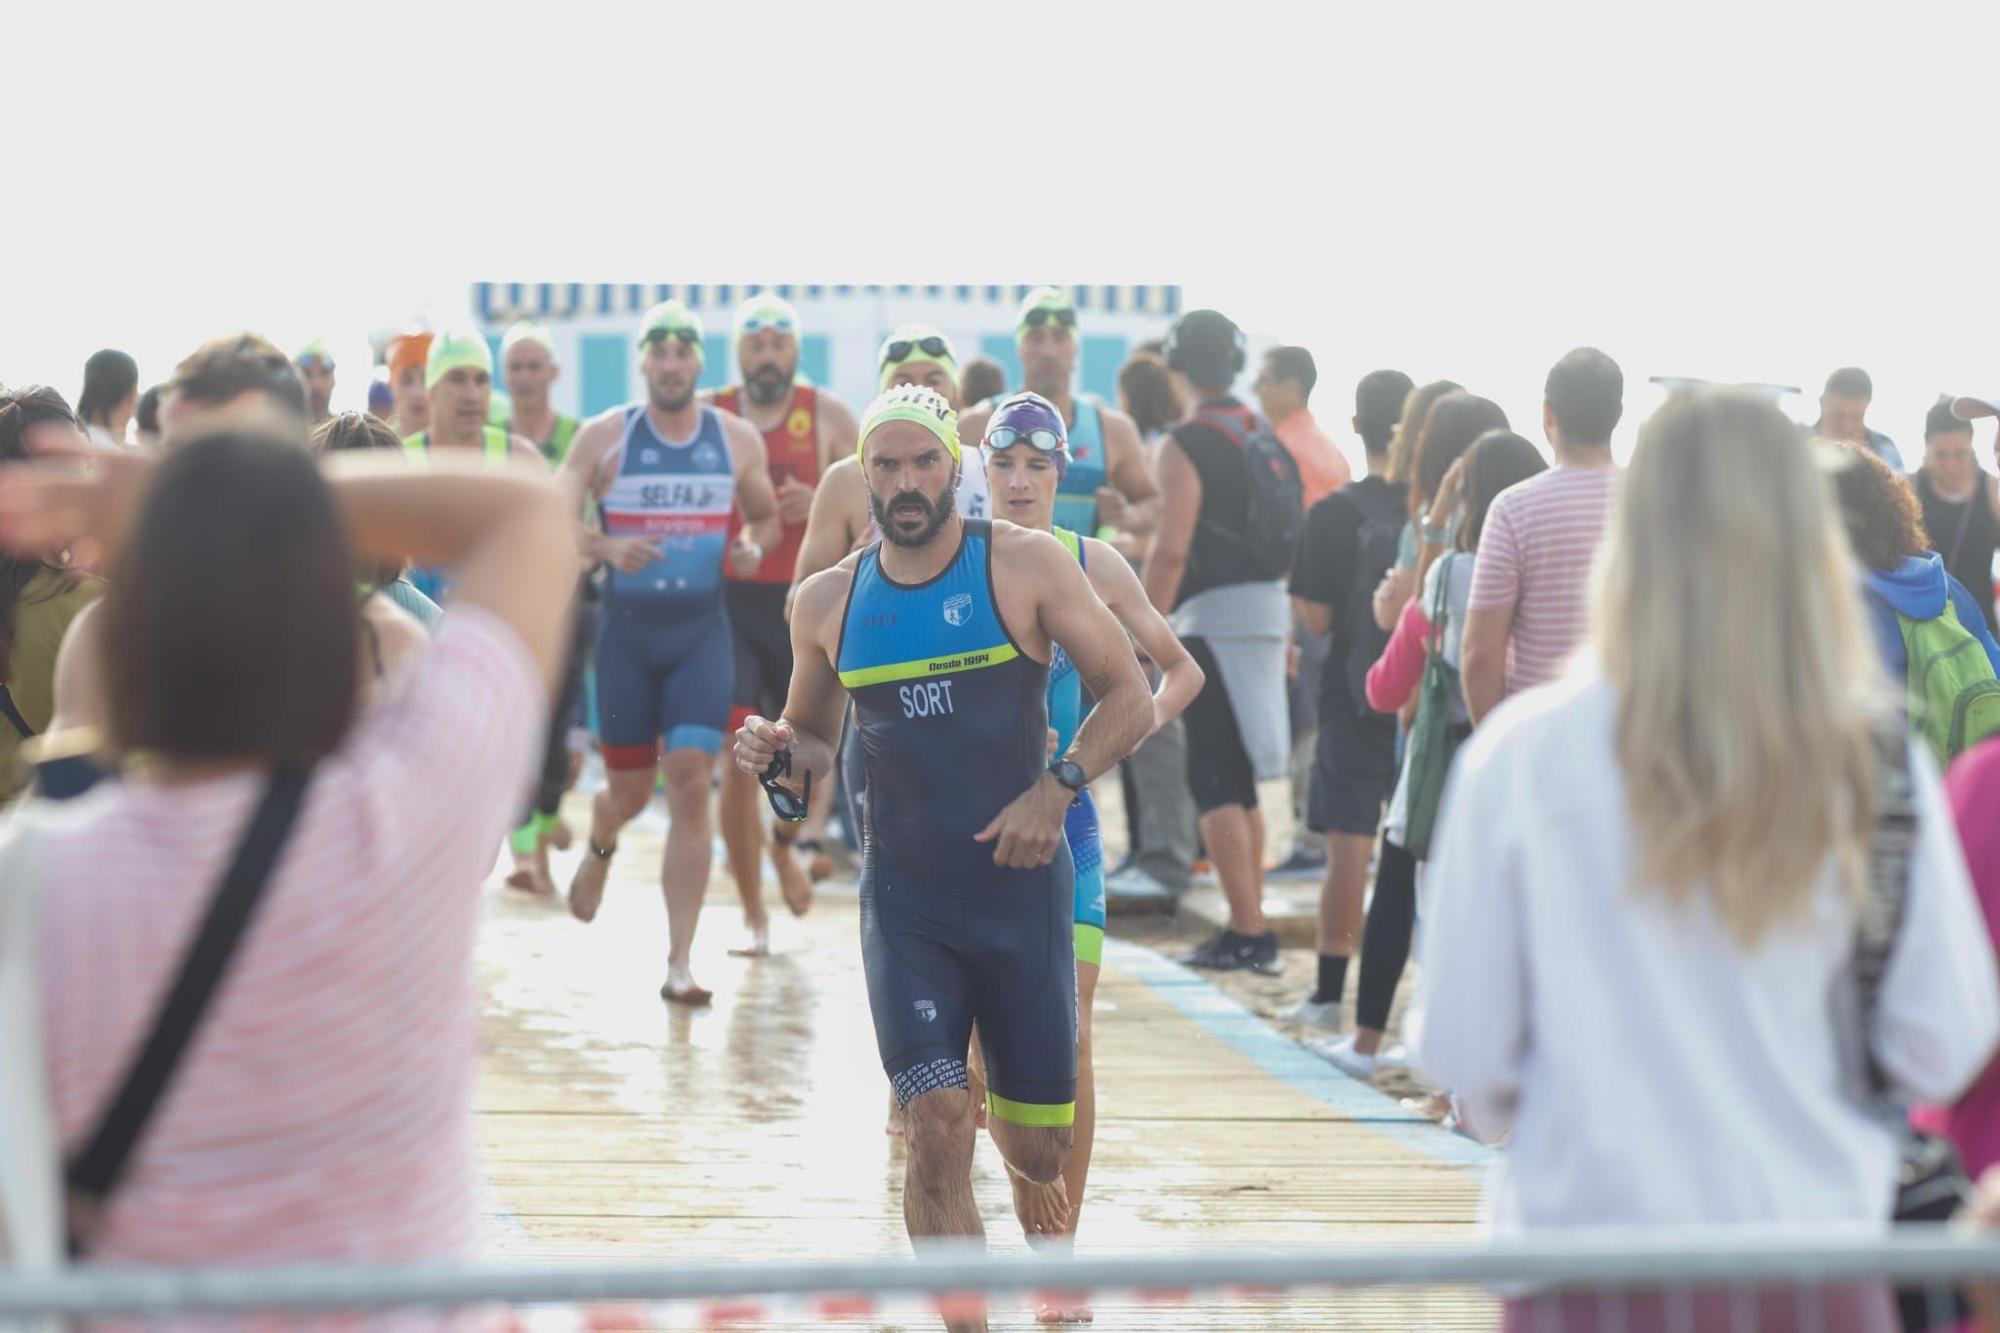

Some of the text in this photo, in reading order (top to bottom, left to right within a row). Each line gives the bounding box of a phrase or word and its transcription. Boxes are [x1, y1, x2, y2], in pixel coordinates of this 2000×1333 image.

[641, 483, 693, 508] SELFA
[929, 654, 989, 672] Desde 1994
[899, 680, 954, 719] SORT
